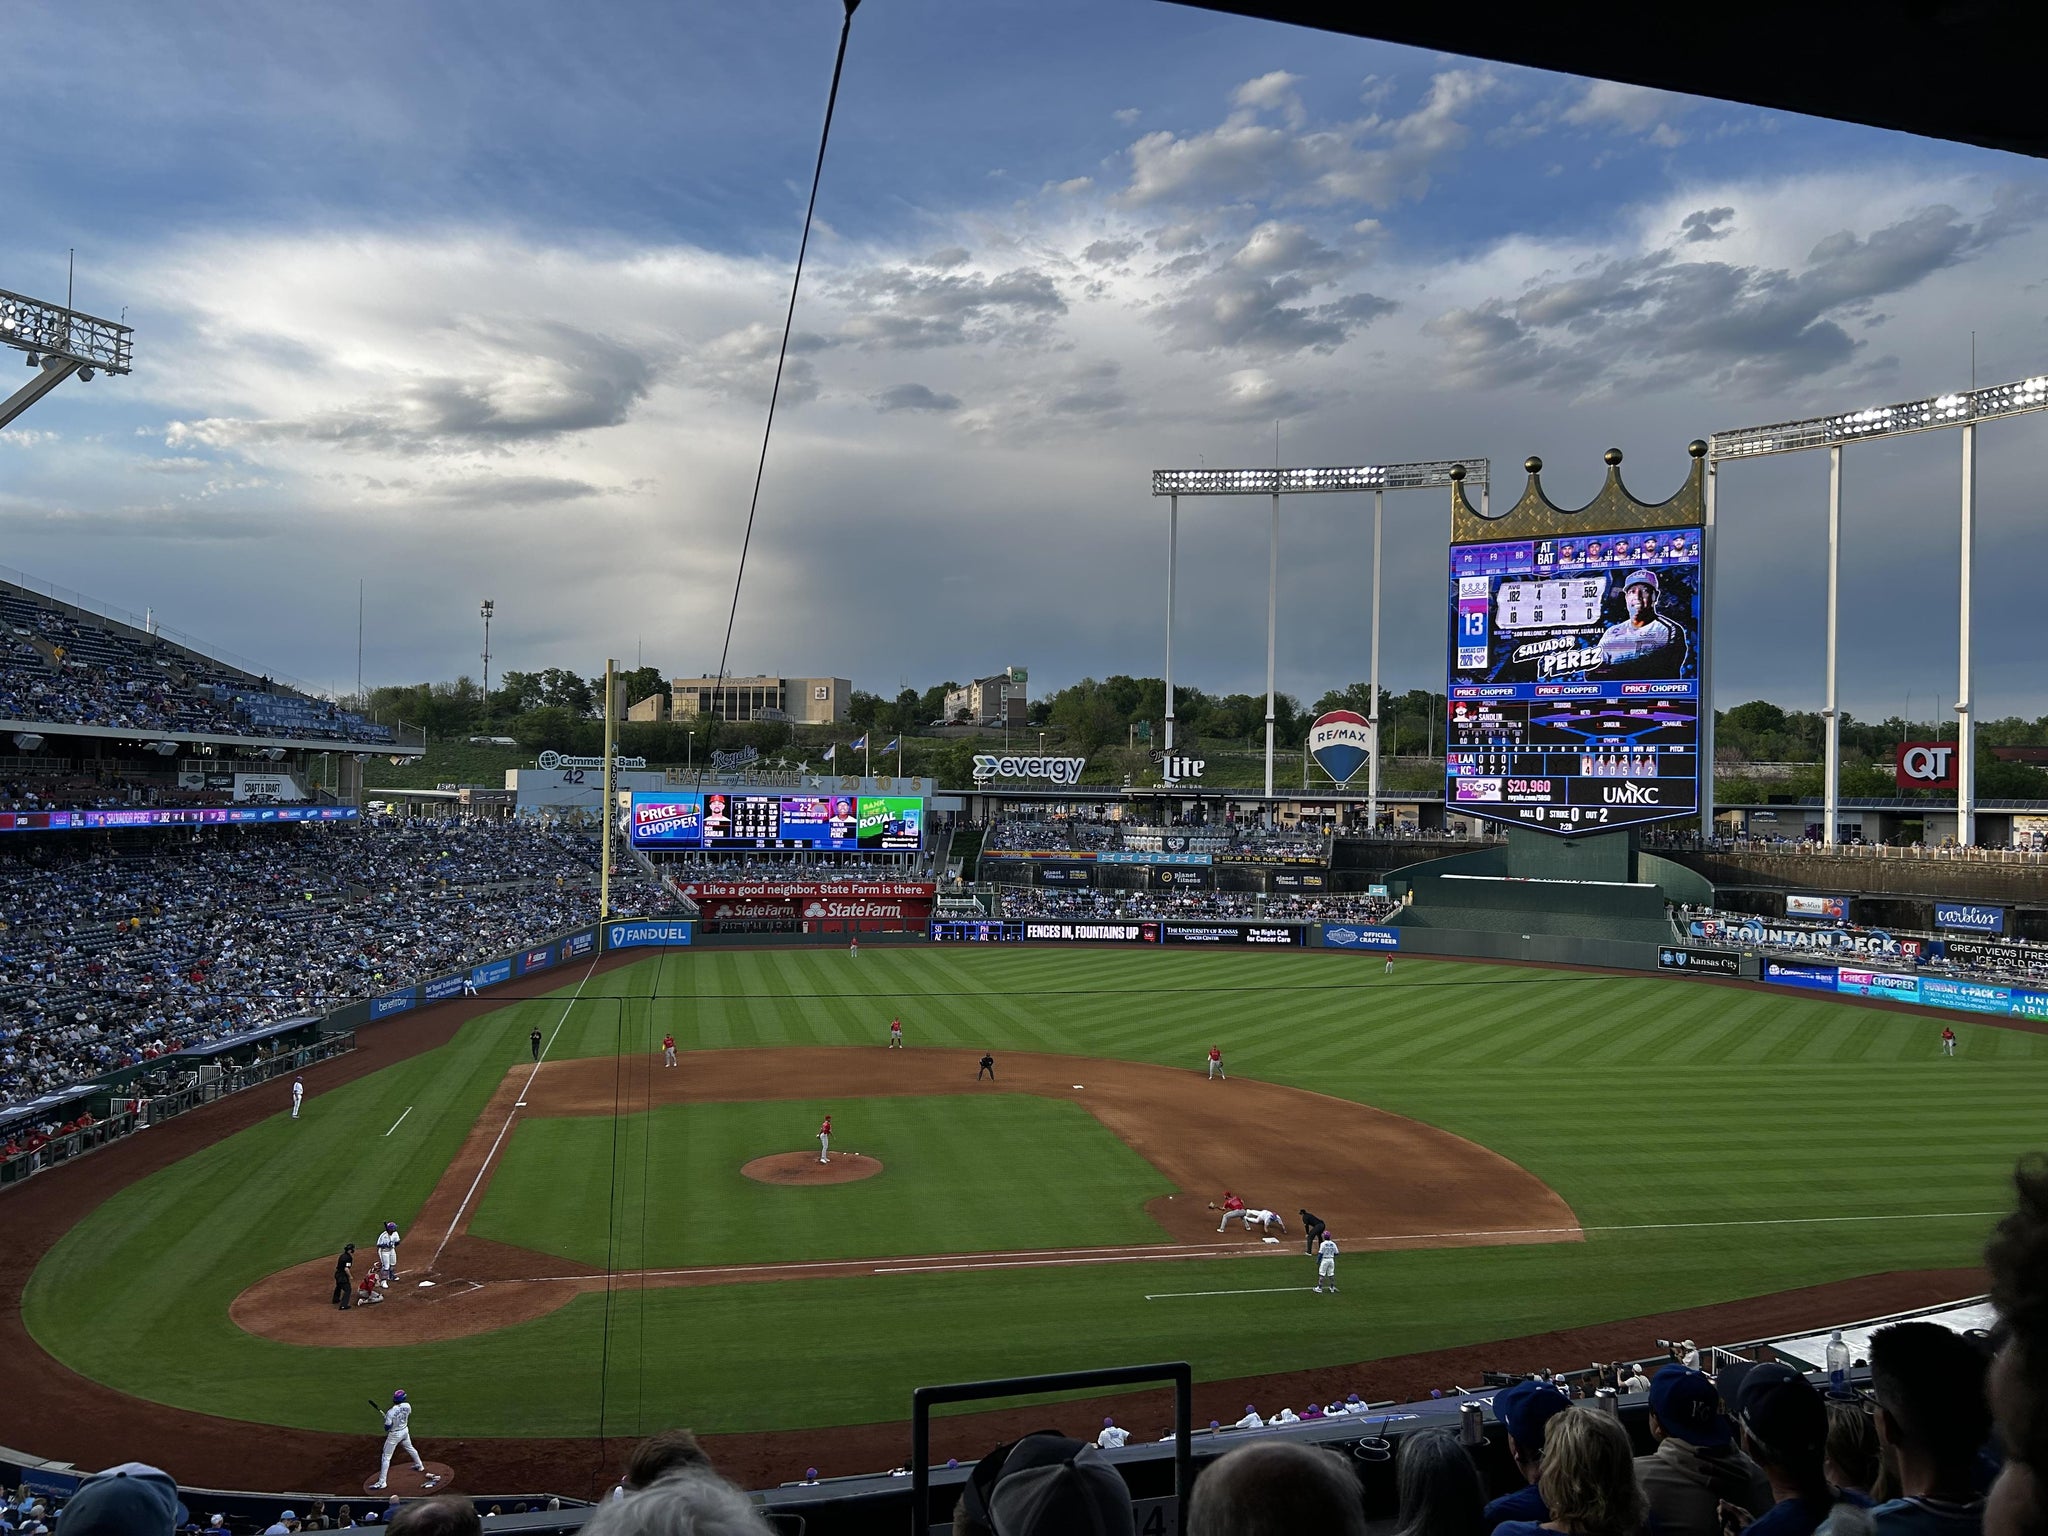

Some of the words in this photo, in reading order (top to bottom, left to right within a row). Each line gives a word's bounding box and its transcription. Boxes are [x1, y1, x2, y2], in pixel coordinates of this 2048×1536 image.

[1540, 542, 1552, 553] AT
[1538, 553, 1555, 565] BAT
[1507, 591, 1520, 602] .182
[1536, 590, 1541, 600] 4
[1562, 589, 1567, 599] 8
[1582, 587, 1597, 599] .552
[1510, 612, 1517, 623] 18
[1534, 611, 1543, 622] 99
[1561, 610, 1566, 620] 3
[1587, 608, 1592, 619] 0
[1519, 637, 1575, 657] SALVADOR
[1544, 648, 1602, 672] PEREZ
[1651, 684, 1688, 692] CHOPPER
[1317, 729, 1366, 743] RE/MAX
[618, 757, 646, 767] Bank
[711, 745, 759, 770] Royals
[1149, 748, 1179, 763] Miller
[1458, 754, 1474, 763] LAA
[1479, 755, 1483, 763] 0
[1490, 755, 1495, 763] 0
[1501, 755, 1506, 763] 0
[1000, 757, 1084, 782] evergy
[1161, 756, 1205, 783] Lite
[1903, 747, 1951, 780] QT
[1460, 766, 1472, 775] KC
[1479, 766, 1483, 775] 0
[1490, 766, 1495, 775] 2
[1501, 766, 1506, 775] 2
[1598, 766, 1604, 775] 6
[1610, 766, 1615, 775] 0
[1622, 766, 1628, 775] 5
[1635, 766, 1641, 775] 4
[1647, 766, 1653, 775] 2
[563, 770, 585, 785] 42
[665, 768, 721, 785] HALL
[726, 776, 739, 788] of
[745, 771, 802, 787] FAME
[840, 775, 860, 791] 20
[875, 776, 892, 791] 10
[911, 776, 921, 791] 5
[244, 783, 260, 792] CRAFT
[261, 783, 265, 792] &
[265, 783, 281, 793] DRAFT
[1508, 780, 1551, 793] $20,960
[1603, 784, 1659, 804] UMKC
[611, 798, 616, 807] 4
[863, 799, 885, 810] BANK
[107, 813, 133, 824] SALVADOR
[134, 812, 149, 823] PEREZ
[640, 805, 677, 821] PRICE
[860, 811, 896, 828] ROYAL
[863, 809, 880, 817] LIKE
[1520, 810, 1534, 818] BALL
[1536, 807, 1544, 821] 0
[1549, 810, 1570, 818] STRIKE
[1571, 807, 1579, 822] 0
[1585, 811, 1598, 819] OUT
[1600, 808, 1608, 822] 2
[638, 817, 698, 837] CHOPPER
[703, 885, 726, 895] Like
[738, 884, 764, 896] good
[767, 884, 817, 896] neighbor,
[820, 885, 849, 894] State
[852, 885, 878, 894] Farm
[882, 884, 891, 894] is
[893, 885, 925, 895] there.
[1938, 907, 1999, 925] carbliss
[627, 928, 686, 941] FANDUEL
[1027, 925, 1060, 938] FENCES
[1062, 926, 1074, 939] IN,
[1075, 926, 1125, 939] FOUNTAINS
[1126, 927, 1139, 939] UP
[1261, 929, 1276, 937] Right
[1726, 926, 1832, 946] FOUNTAIN
[1840, 934, 1897, 953] DECK
[1903, 943, 1917, 954] QT
[1951, 944, 1981, 955] GREAT
[1986, 947, 2016, 957] VIEWS
[1690, 957, 1719, 967] Kansas
[1721, 959, 1737, 970] City
[1780, 968, 1815, 979] Commerce
[1816, 973, 1833, 981] Bank
[1843, 974, 1868, 983] PRICE
[1872, 977, 1914, 990] CHOPPER
[1924, 981, 1958, 994] SUNDAY
[1961, 986, 1994, 998] 4-PACK
